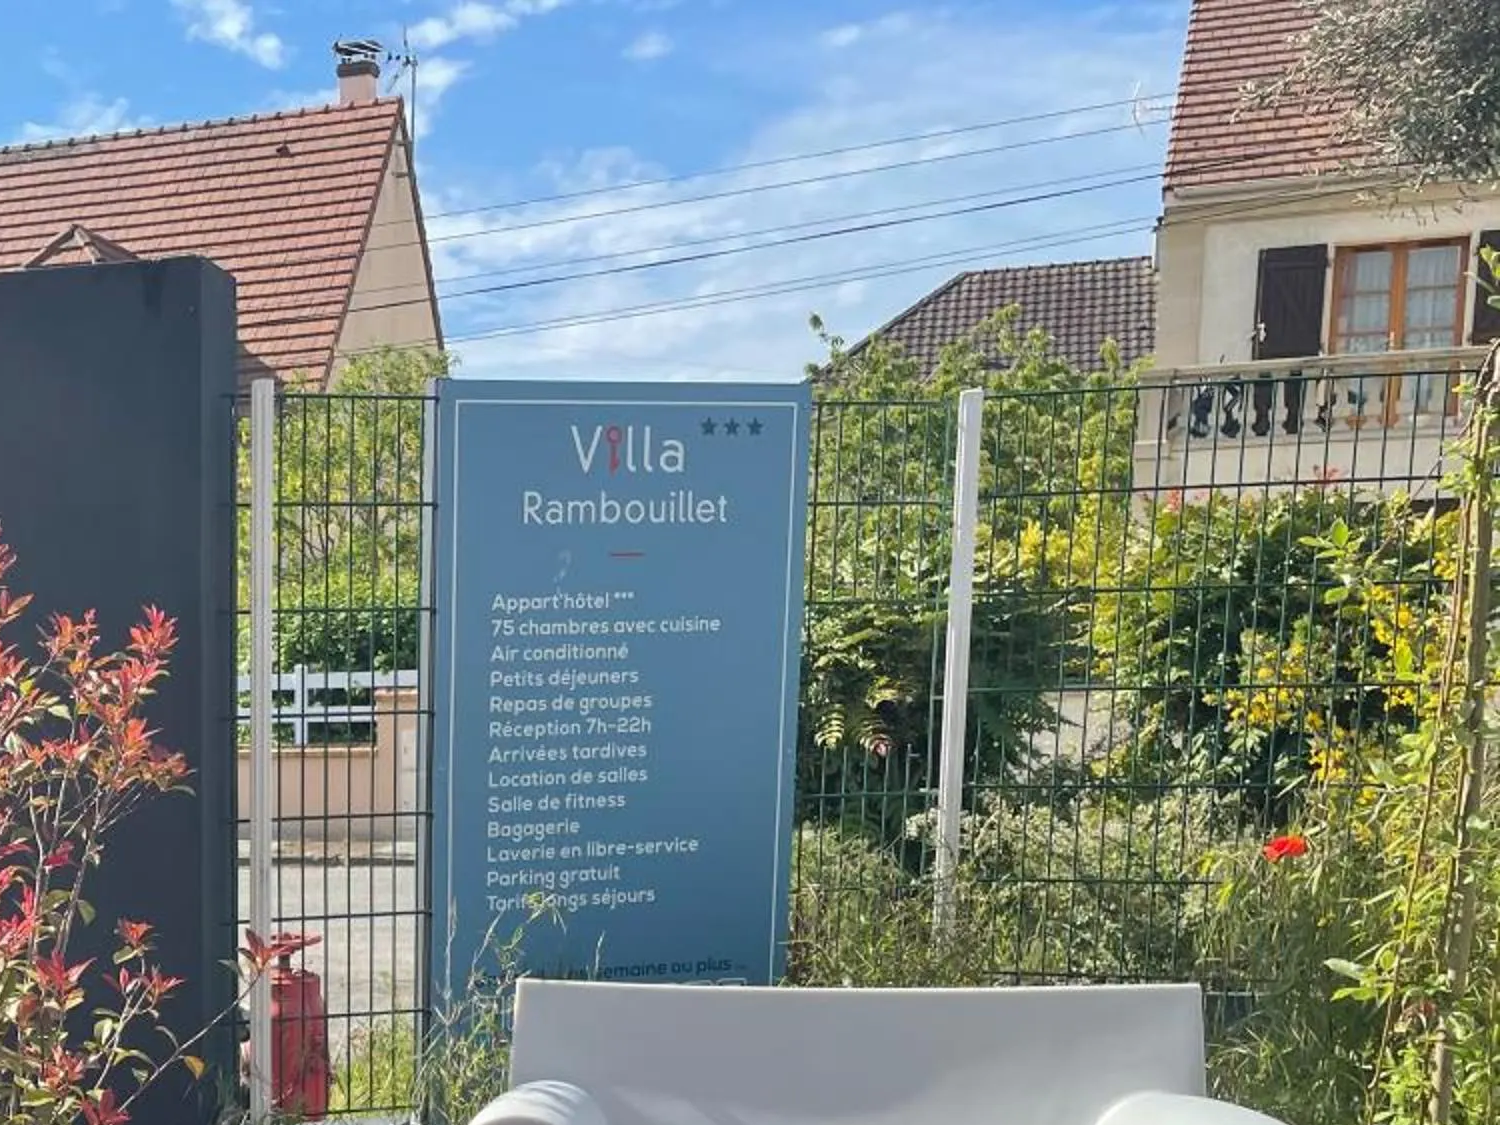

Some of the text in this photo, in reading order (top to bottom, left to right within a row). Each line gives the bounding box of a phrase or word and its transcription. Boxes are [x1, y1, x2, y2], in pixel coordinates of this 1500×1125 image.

[571, 425, 686, 475] Villa
[523, 490, 729, 525] Rambouillet
[491, 592, 610, 614] Appart'hôtel
[491, 617, 721, 637] 75 chambres avec cuisine
[490, 643, 629, 662] Air conditionné
[489, 668, 639, 691] Petits déjeuners
[489, 694, 653, 716] Repas de groupes
[488, 718, 652, 741] Réception 7h-22h
[488, 743, 648, 764] Arrivées tardives
[488, 767, 648, 788] Location de salles
[488, 792, 626, 814] Salle de fitness
[487, 819, 580, 842] Bagagerie
[487, 837, 699, 863] Laverie en libre-service
[487, 865, 621, 889] Parking gratuit
[592, 887, 655, 910] séjours
[671, 962, 693, 975] ou
[696, 957, 732, 976] plus
